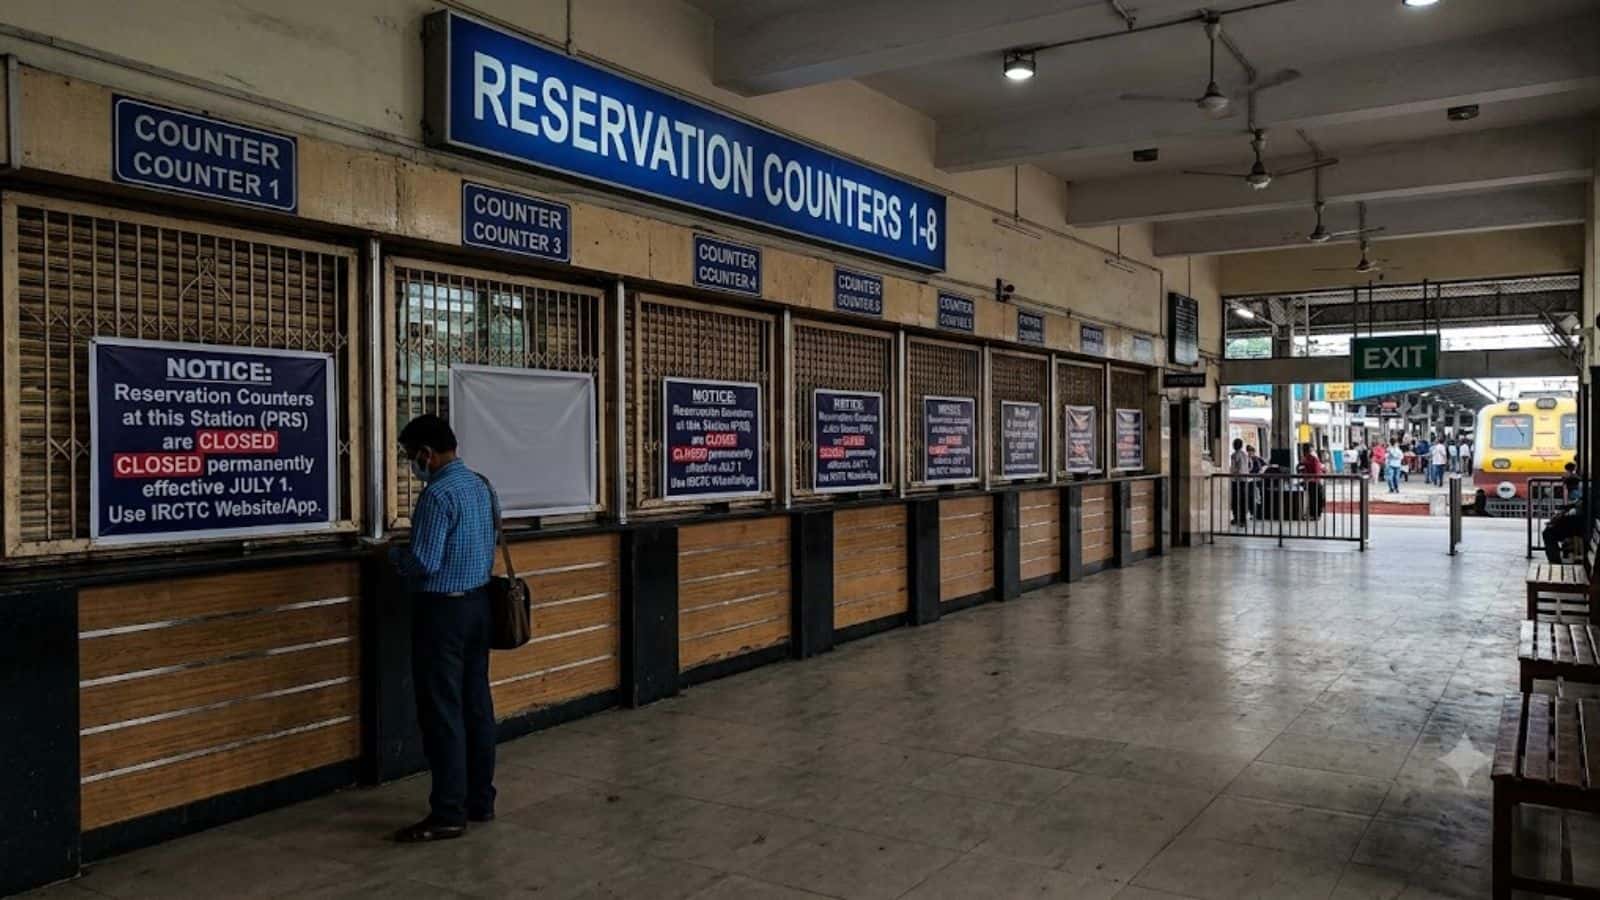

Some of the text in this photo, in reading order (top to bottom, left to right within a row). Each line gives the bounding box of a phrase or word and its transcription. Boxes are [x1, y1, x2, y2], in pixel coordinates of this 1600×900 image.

[134, 114, 281, 169] COUNTER
[473, 51, 937, 251] RESERVATION COUNTERS 1-8
[133, 151, 280, 201] COUNTER 1
[473, 193, 562, 230] COUNTER
[472, 221, 562, 255] COUNTER 3
[699, 243, 757, 270] COUNTER
[166, 357, 272, 383] NOTICE:
[1363, 344, 1427, 370] EXIT
[114, 383, 314, 406] Reservation Counters
[122, 409, 308, 431] at this Station (PRS)
[163, 432, 276, 450] are CLOSED
[116, 455, 315, 476] CLOSED permanently
[142, 477, 293, 497] effective JULY 1.
[109, 498, 322, 524] Use IRCTC Website/App.
